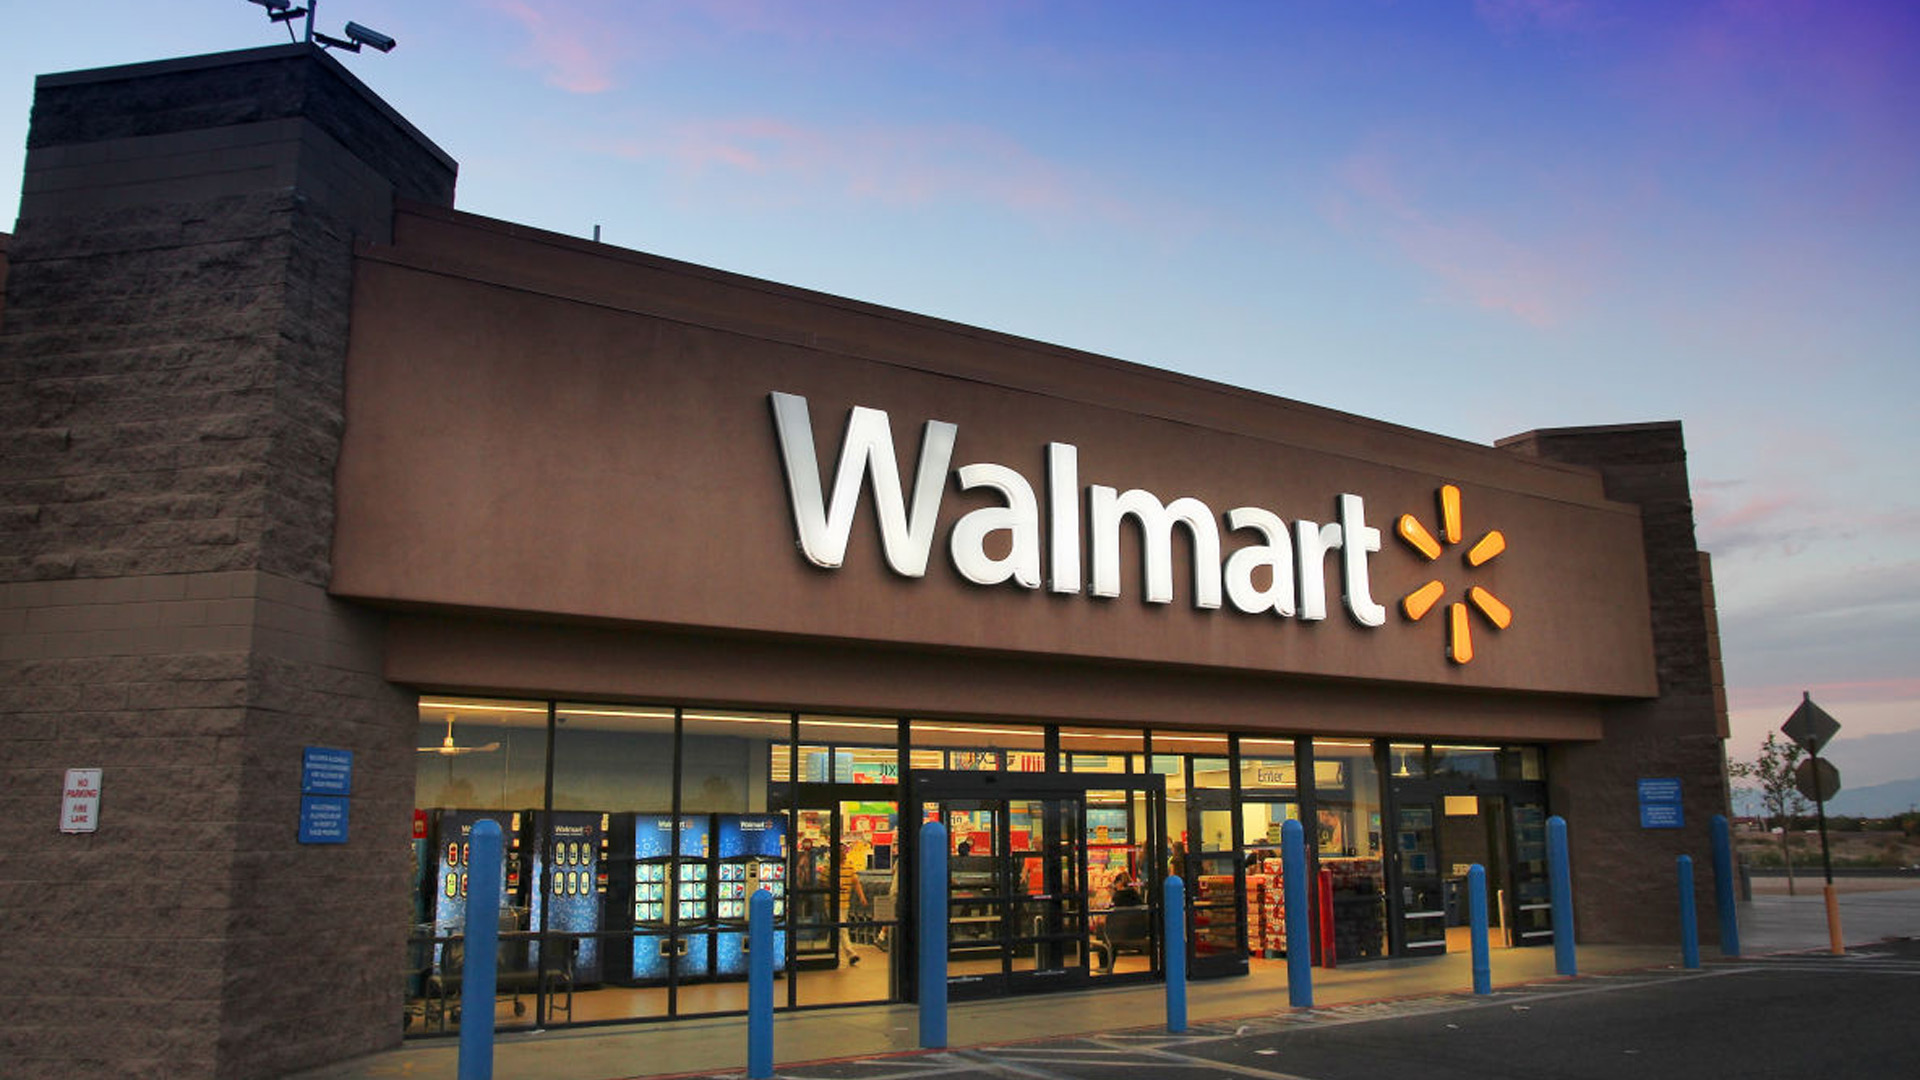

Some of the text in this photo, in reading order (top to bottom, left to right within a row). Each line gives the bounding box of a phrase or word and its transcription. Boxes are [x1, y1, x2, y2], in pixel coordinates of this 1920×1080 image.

[770, 391, 1385, 627] Walmart
[1257, 769, 1283, 782] Enter
[78, 778, 88, 787] NO
[66, 789, 97, 798] PARKING
[73, 804, 88, 813] FIRE
[71, 815, 88, 823] LANE
